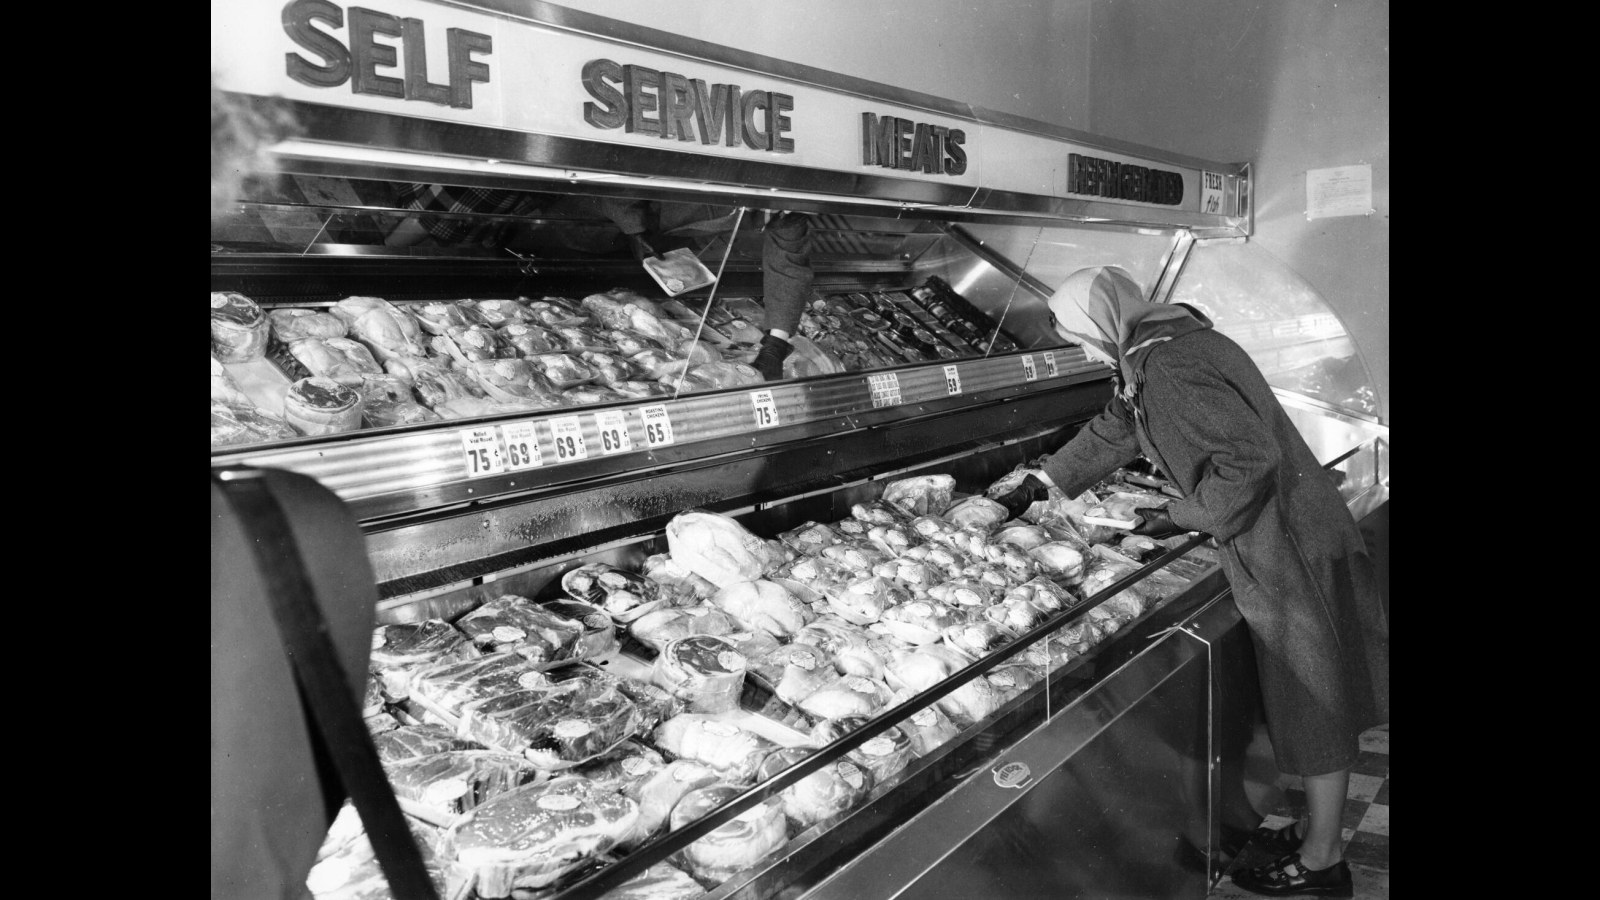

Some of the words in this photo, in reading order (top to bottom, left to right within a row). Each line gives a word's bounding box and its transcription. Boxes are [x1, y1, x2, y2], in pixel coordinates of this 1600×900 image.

[281, 0, 492, 109] SELF
[581, 58, 795, 153] SERVICE
[862, 112, 967, 176] MEATS
[1205, 172, 1222, 191] FRESH
[948, 378, 957, 393] 59
[756, 407, 771, 425] 75
[602, 429, 621, 450] 69
[646, 423, 665, 444] 65
[509, 442, 531, 467] 69
[556, 436, 576, 459] 69
[467, 448, 491, 472] 75
